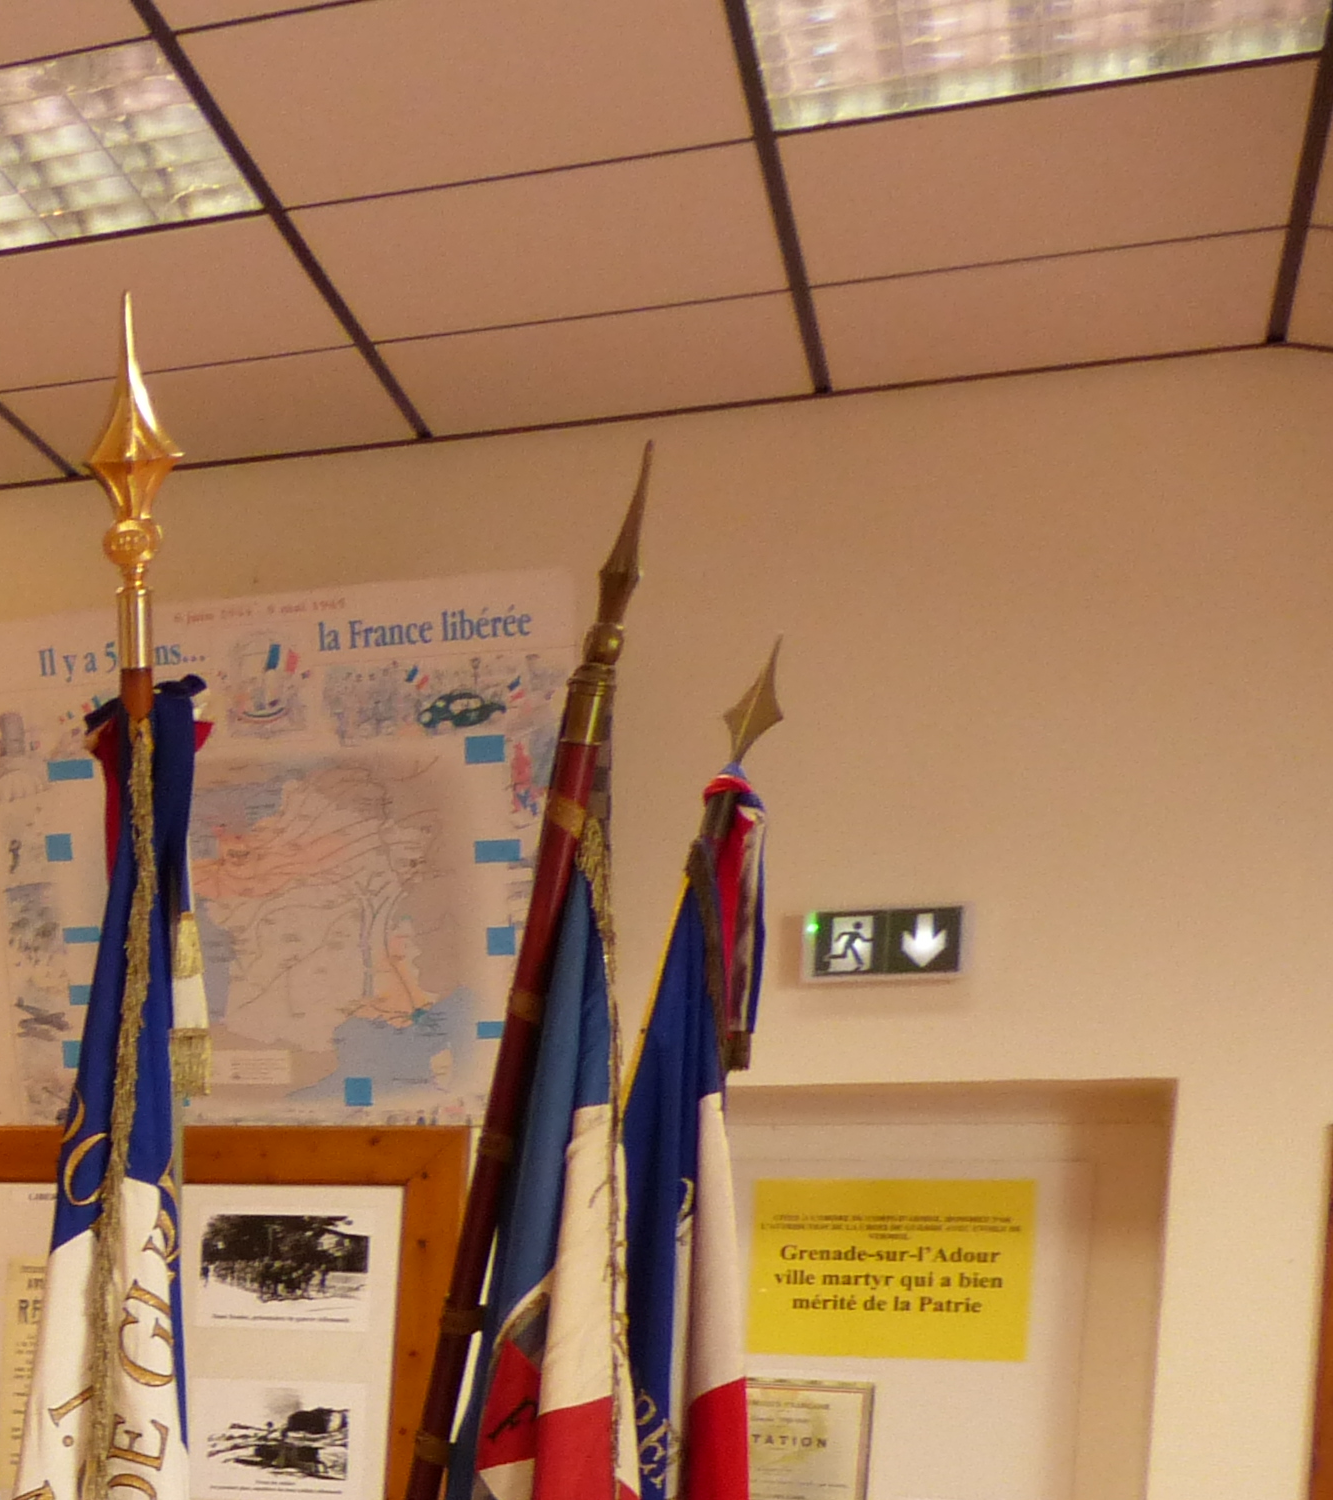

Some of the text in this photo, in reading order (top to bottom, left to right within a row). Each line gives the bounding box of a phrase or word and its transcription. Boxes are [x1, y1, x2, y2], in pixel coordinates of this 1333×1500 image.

[318, 604, 532, 651] la France libérée
[63, 655, 77, 683] y
[85, 651, 98, 674] a
[153, 644, 205, 667] ns...
[774, 1268, 1003, 1291] ville martyr qui a bien
[792, 1293, 983, 1313] mérité de la Patrie
[751, 1433, 827, 1448] TATION
